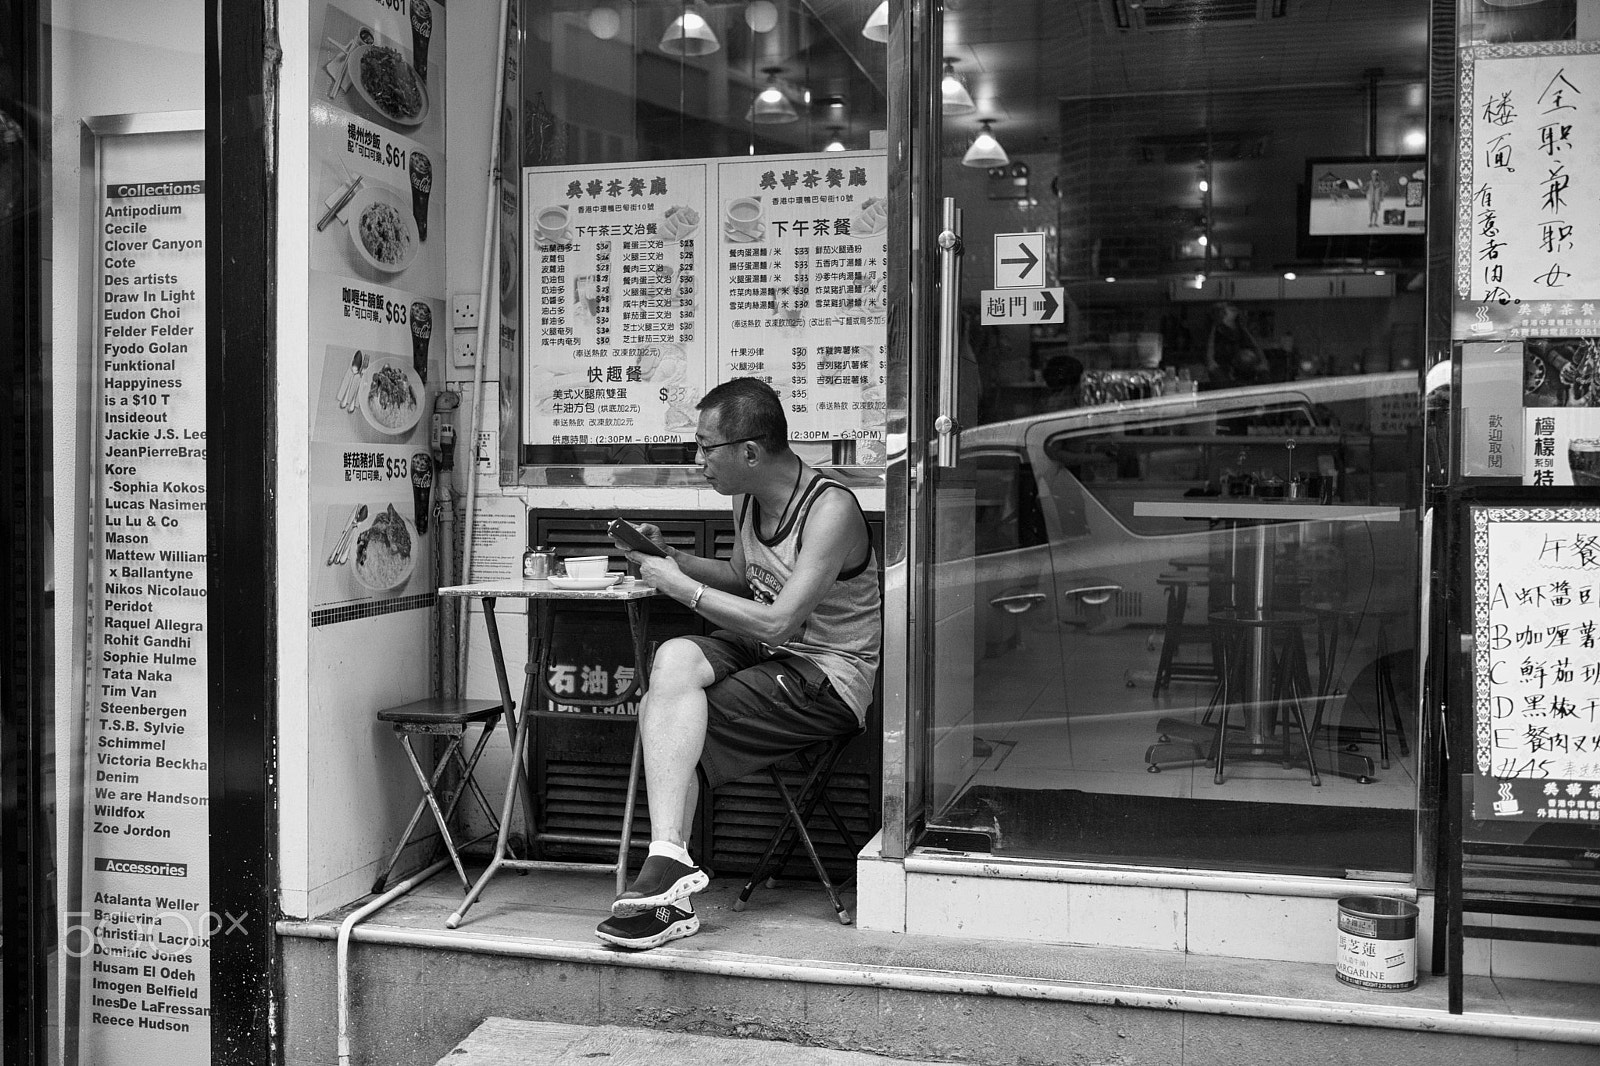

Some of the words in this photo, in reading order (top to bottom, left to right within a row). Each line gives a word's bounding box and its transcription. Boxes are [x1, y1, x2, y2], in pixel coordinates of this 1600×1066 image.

[386, 143, 405, 170] $61
[117, 182, 200, 197] Collections
[105, 204, 182, 219] Antipodium
[105, 223, 147, 235] Cecile
[575, 223, 658, 237] 下午茶三文治餐
[772, 218, 851, 237] 下午茶餐
[105, 241, 148, 251] Clover
[152, 238, 203, 250] Canyon
[105, 258, 136, 268] Cote
[623, 252, 663, 261] 火腿三文治
[105, 275, 129, 286] Des
[134, 274, 177, 285] artists
[105, 292, 139, 303] Draw
[144, 291, 156, 302] In
[160, 290, 195, 303] Light
[104, 309, 146, 320] Eudon
[150, 308, 180, 319] Choi
[386, 300, 406, 324] $63
[987, 297, 1027, 317] 趟門
[104, 326, 146, 337] Felder
[151, 325, 193, 337] Felder
[104, 344, 144, 357] Fyodo
[148, 342, 187, 354] Golan
[104, 360, 175, 372] Funktional
[587, 365, 642, 383] 快趣餐
[104, 378, 182, 391] Happyiness
[105, 395, 116, 406] is
[121, 398, 128, 406] a
[133, 394, 157, 406] $10
[162, 395, 170, 405] T
[553, 388, 627, 399] 美式火腿煎雙蛋
[553, 402, 595, 413] 牛油方包
[105, 412, 167, 423] Insideout
[105, 429, 150, 441] Jackie
[154, 429, 179, 440] J.S.
[184, 429, 207, 440] Lee
[1534, 417, 1555, 457] 檸檬
[344, 452, 384, 468] 鮮茄豬扒飯
[1534, 458, 1553, 468] 系列
[105, 464, 136, 475] Kore
[386, 457, 407, 480] $53
[109, 482, 158, 494] -Sophia
[106, 498, 145, 510] Lucas
[106, 516, 122, 527] Lu
[126, 516, 142, 527] Lu
[146, 517, 156, 527] &
[160, 518, 179, 528] Co
[106, 533, 148, 544] Mason
[106, 550, 155, 562] Mattew
[110, 569, 117, 577] x
[122, 567, 193, 580] Ballantyne
[106, 584, 144, 595] Nikos
[148, 585, 207, 597] Nicolauo
[1491, 583, 1508, 610] A
[106, 601, 152, 613] Peridot
[105, 618, 151, 631] Raquel
[155, 620, 203, 633] Allegra
[104, 634, 139, 646] Rohit
[144, 636, 191, 649] Gandhi
[1491, 624, 1511, 650] B
[103, 651, 149, 665] Sophie
[153, 654, 197, 666] Hulme
[103, 668, 133, 680] Tata
[138, 670, 172, 682] Naka
[1491, 660, 1508, 685] C
[102, 685, 127, 697] Tim
[131, 687, 157, 699] Van
[100, 702, 187, 718] Steenbergen
[1492, 696, 1513, 719] D
[100, 720, 139, 732] T.S.B.
[144, 722, 185, 736] Sylvie
[98, 737, 165, 750] Schimmel
[1494, 729, 1518, 749] E
[98, 754, 151, 767] Victoria
[96, 771, 139, 784] Denim
[95, 788, 116, 800] We
[121, 791, 142, 802] are
[95, 805, 145, 819] Wildfox
[94, 822, 119, 835] Zoe
[124, 824, 170, 839] Jordon
[106, 860, 185, 876] Accessories
[94, 892, 151, 907] Atalanta
[156, 897, 199, 911] Weller
[94, 927, 154, 942] Christian
[159, 932, 210, 948] Lacroix
[94, 944, 147, 959] Dominic
[152, 950, 192, 963] Jones
[93, 961, 138, 975] Husam
[144, 966, 155, 977] El
[161, 968, 195, 981] Odeh
[93, 978, 141, 994] Imogen
[146, 984, 197, 999] Belfield
[93, 996, 137, 1010] InesDe
[93, 1013, 134, 1026] Reece
[139, 1017, 189, 1032] Hudson
